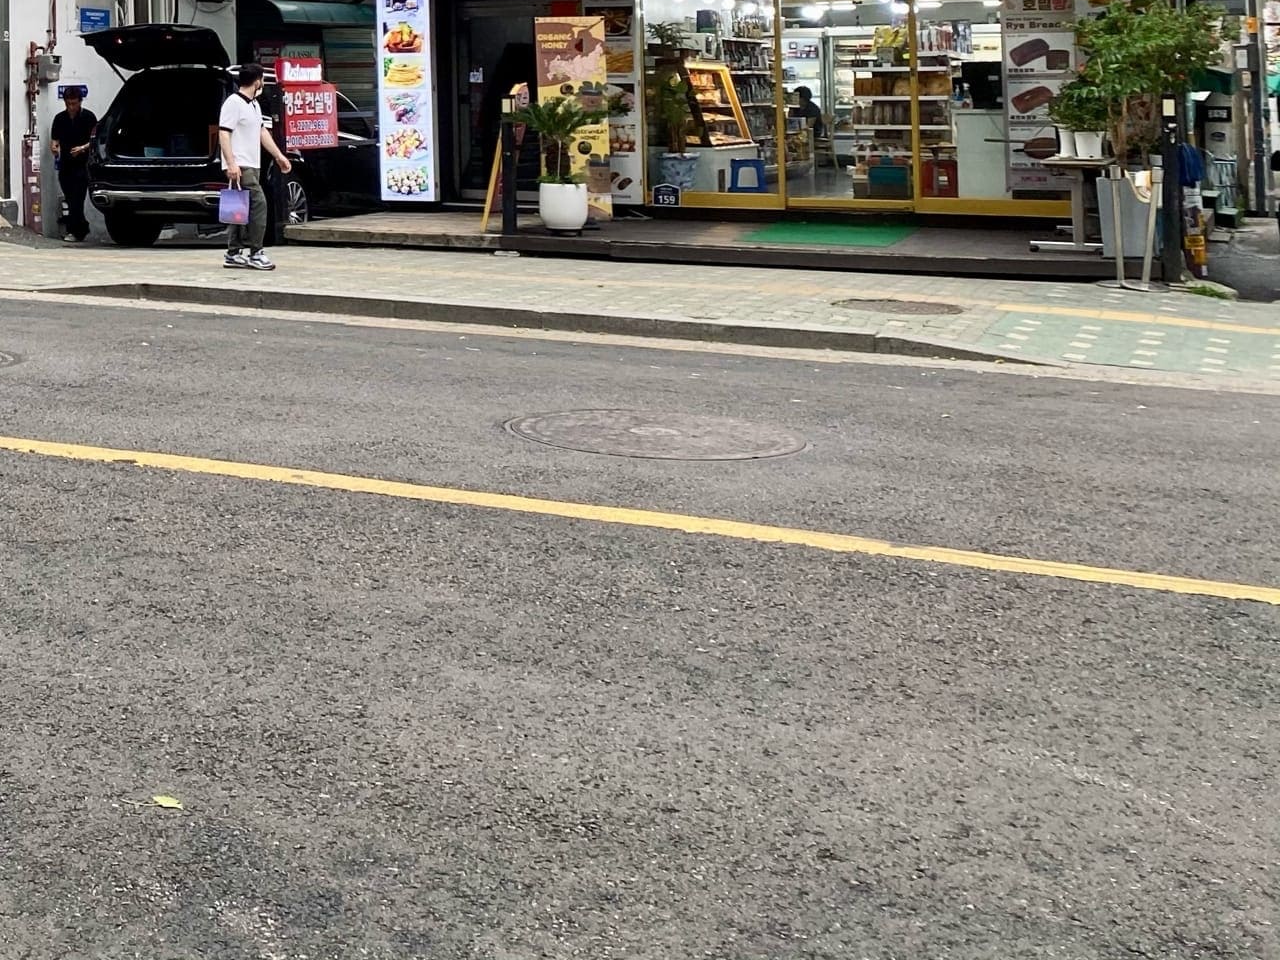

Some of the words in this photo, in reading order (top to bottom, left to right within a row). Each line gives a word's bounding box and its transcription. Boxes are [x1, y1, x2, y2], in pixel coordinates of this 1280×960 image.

[1006, 22, 1025, 30] Rye
[541, 41, 569, 49] HONEY
[657, 194, 676, 204] 159
